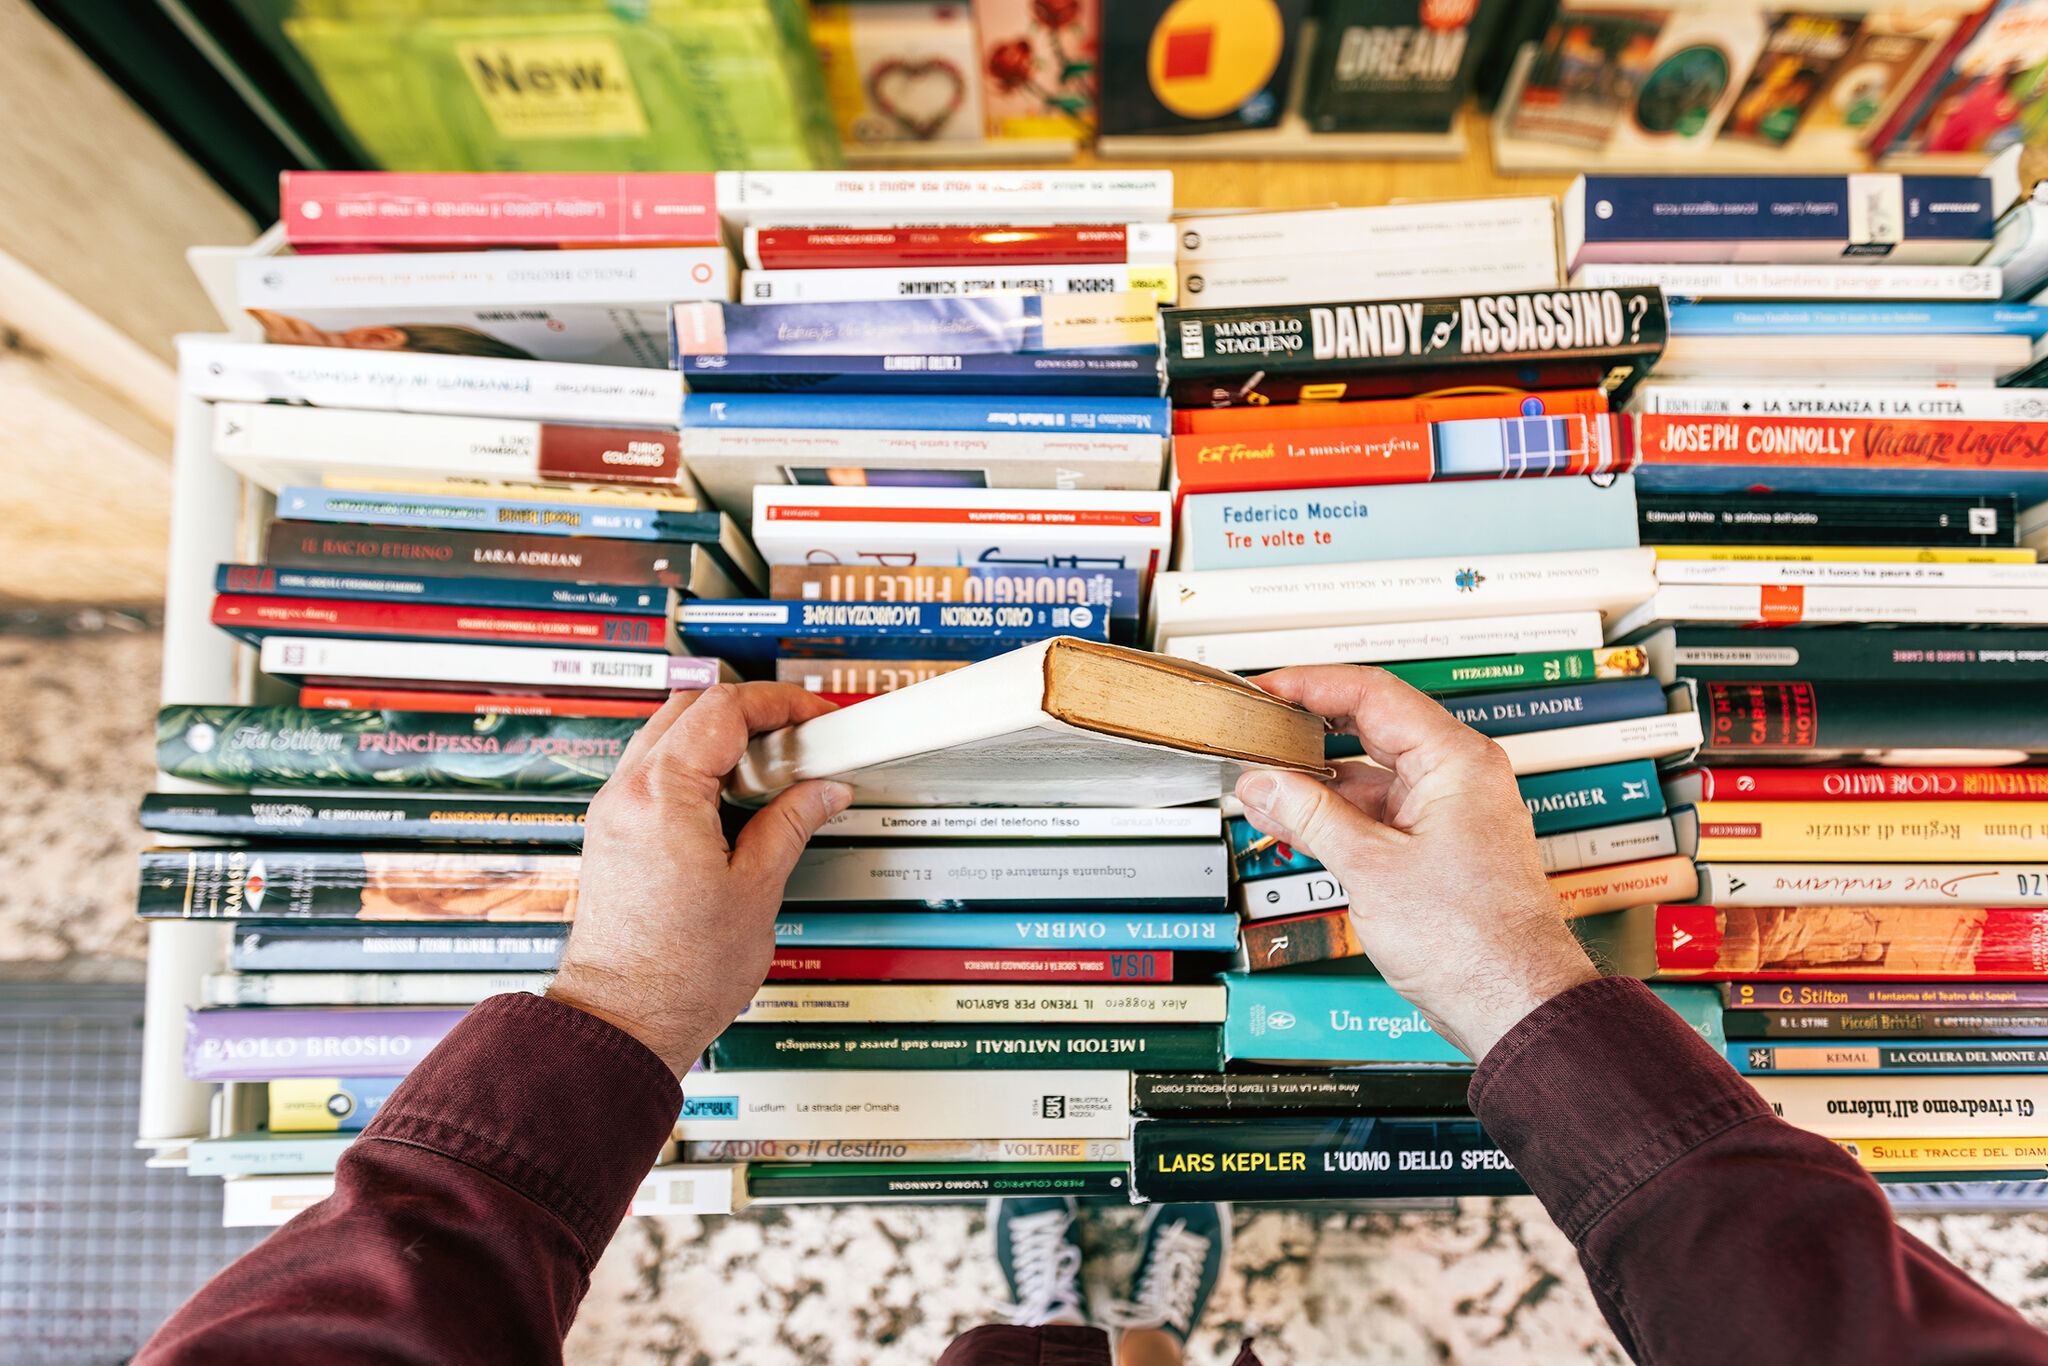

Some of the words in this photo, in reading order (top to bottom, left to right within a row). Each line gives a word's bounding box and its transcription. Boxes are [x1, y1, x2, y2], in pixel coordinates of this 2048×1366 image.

[1214, 319, 1303, 338] MARCELLO
[1310, 302, 1424, 359] DANDY
[1215, 335, 1304, 354] STAGLIENO
[1763, 400, 1780, 413] LA
[1788, 400, 1873, 414] SPERANZA
[1894, 400, 1912, 413] LA
[1198, 445, 1226, 464] Kat
[1228, 442, 1275, 463] French
[1288, 444, 1305, 457] La
[1309, 442, 1363, 457] musica
[1366, 436, 1420, 459] perfetta
[1660, 423, 1738, 453] JOSEPH
[1746, 425, 1857, 455] CONNOLLY
[1863, 422, 1953, 463] Vacanze
[1223, 502, 1299, 524] Federico
[1307, 500, 1369, 520] Moccia
[1225, 531, 1252, 549] Tre
[1262, 529, 1305, 547] volte
[1314, 529, 1333, 546] te
[473, 548, 517, 565] LARA
[517, 551, 582, 568] ADRIAN
[995, 607, 1033, 627] CARLO
[1452, 663, 1525, 681] FITZGERALD
[1543, 660, 1560, 681] 73
[1493, 701, 1526, 720] DEL
[1529, 696, 1584, 717] PADRE
[358, 731, 500, 755] PRINCIPESSA
[529, 735, 621, 758] FORESTE
[1890, 773, 1957, 795] CUORE
[1528, 786, 1608, 816] DAGGER
[882, 816, 928, 827] L'amore
[930, 816, 941, 827] ai
[943, 816, 977, 829] tempi
[979, 816, 999, 827] del
[1001, 816, 1048, 827] telefono
[1051, 816, 1080, 827] fisso
[1900, 820, 1961, 840] Regina
[1805, 824, 1870, 839] astuzie
[1874, 825, 1893, 840] di
[1984, 824, 2033, 840] Dunn
[869, 869, 912, 881] James
[915, 869, 922, 880] L
[926, 869, 932, 880] E
[948, 865, 989, 880] Grigio
[989, 867, 1003, 880] di
[1005, 866, 1070, 880] sfumature
[1072, 865, 1137, 880] Cinquanta
[1559, 880, 1609, 900] ARSLAN
[1612, 874, 1669, 892] ANTONIA
[1774, 876, 1893, 897] andiamo
[1904, 871, 2000, 899] Dove
[1016, 921, 1106, 938] OMBRA
[1126, 922, 1216, 938] RIOTTA
[1110, 953, 1155, 978] USA
[1741, 985, 1754, 1004] 10
[1779, 987, 1796, 1004] G.
[1800, 987, 1848, 1004] Stilton
[956, 999, 1010, 1011] BABYLON
[1013, 999, 1036, 1010] PER
[1040, 999, 1079, 1010] TRENO
[1083, 999, 1094, 1010] IL
[1105, 996, 1156, 1010] Roggero
[1160, 999, 1187, 1011] Alex
[1329, 1010, 1363, 1031] Un
[203, 1037, 296, 1059] PAOLO
[304, 1036, 412, 1058] BROSIO
[775, 1038, 840, 1052] sessuologia
[844, 1040, 857, 1052] di
[860, 1037, 899, 1050] pavese
[901, 1040, 929, 1052] studi
[931, 1040, 968, 1051] centro
[975, 1040, 1061, 1054] NATURALI
[1067, 1038, 1136, 1053] METODI
[1139, 1038, 1146, 1053] I
[1826, 1053, 1869, 1064] KEMAL
[1890, 1052, 1908, 1063] LA
[1910, 1052, 1963, 1063] COLLERA
[1965, 1051, 1990, 1063] DEL
[1992, 1051, 2031, 1063] MONTE
[1151, 1085, 1184, 1094] POIROT
[1185, 1084, 1225, 1094] HERCULE
[1239, 1084, 1264, 1093] TEMPI
[1280, 1084, 1298, 1093] VITA
[1299, 1084, 1311, 1093] LA
[1318, 1084, 1337, 1093] Hart
[1338, 1084, 1360, 1093] Anne
[749, 1102, 786, 1113] Ludlum
[796, 1102, 808, 1113] La
[810, 1102, 842, 1113] strada
[844, 1104, 862, 1115] per
[864, 1102, 900, 1113] Omaha
[1826, 1099, 1919, 1118] all'inferno
[1922, 1099, 2014, 1117] rivedremo
[2016, 1099, 2034, 1117] Ci
[785, 1143, 801, 1157] o
[807, 1140, 821, 1157] il
[826, 1140, 907, 1158] destino
[1003, 1144, 1081, 1158] VOLTAIRE
[1872, 1146, 1918, 1159] SULLE
[1925, 1146, 1978, 1159] TRACCE
[1984, 1146, 2009, 1158] DEL
[1158, 1153, 1215, 1174] LARS
[1221, 1152, 1306, 1174] KEPLER
[1323, 1151, 1391, 1172] L'UOMO
[1398, 1150, 1453, 1171] DELLO
[889, 1180, 943, 1191] CANNONE
[945, 1180, 988, 1190] L'UOMO
[993, 1179, 1052, 1190] COLAPRICO
[1054, 1178, 1085, 1189] PIERO
